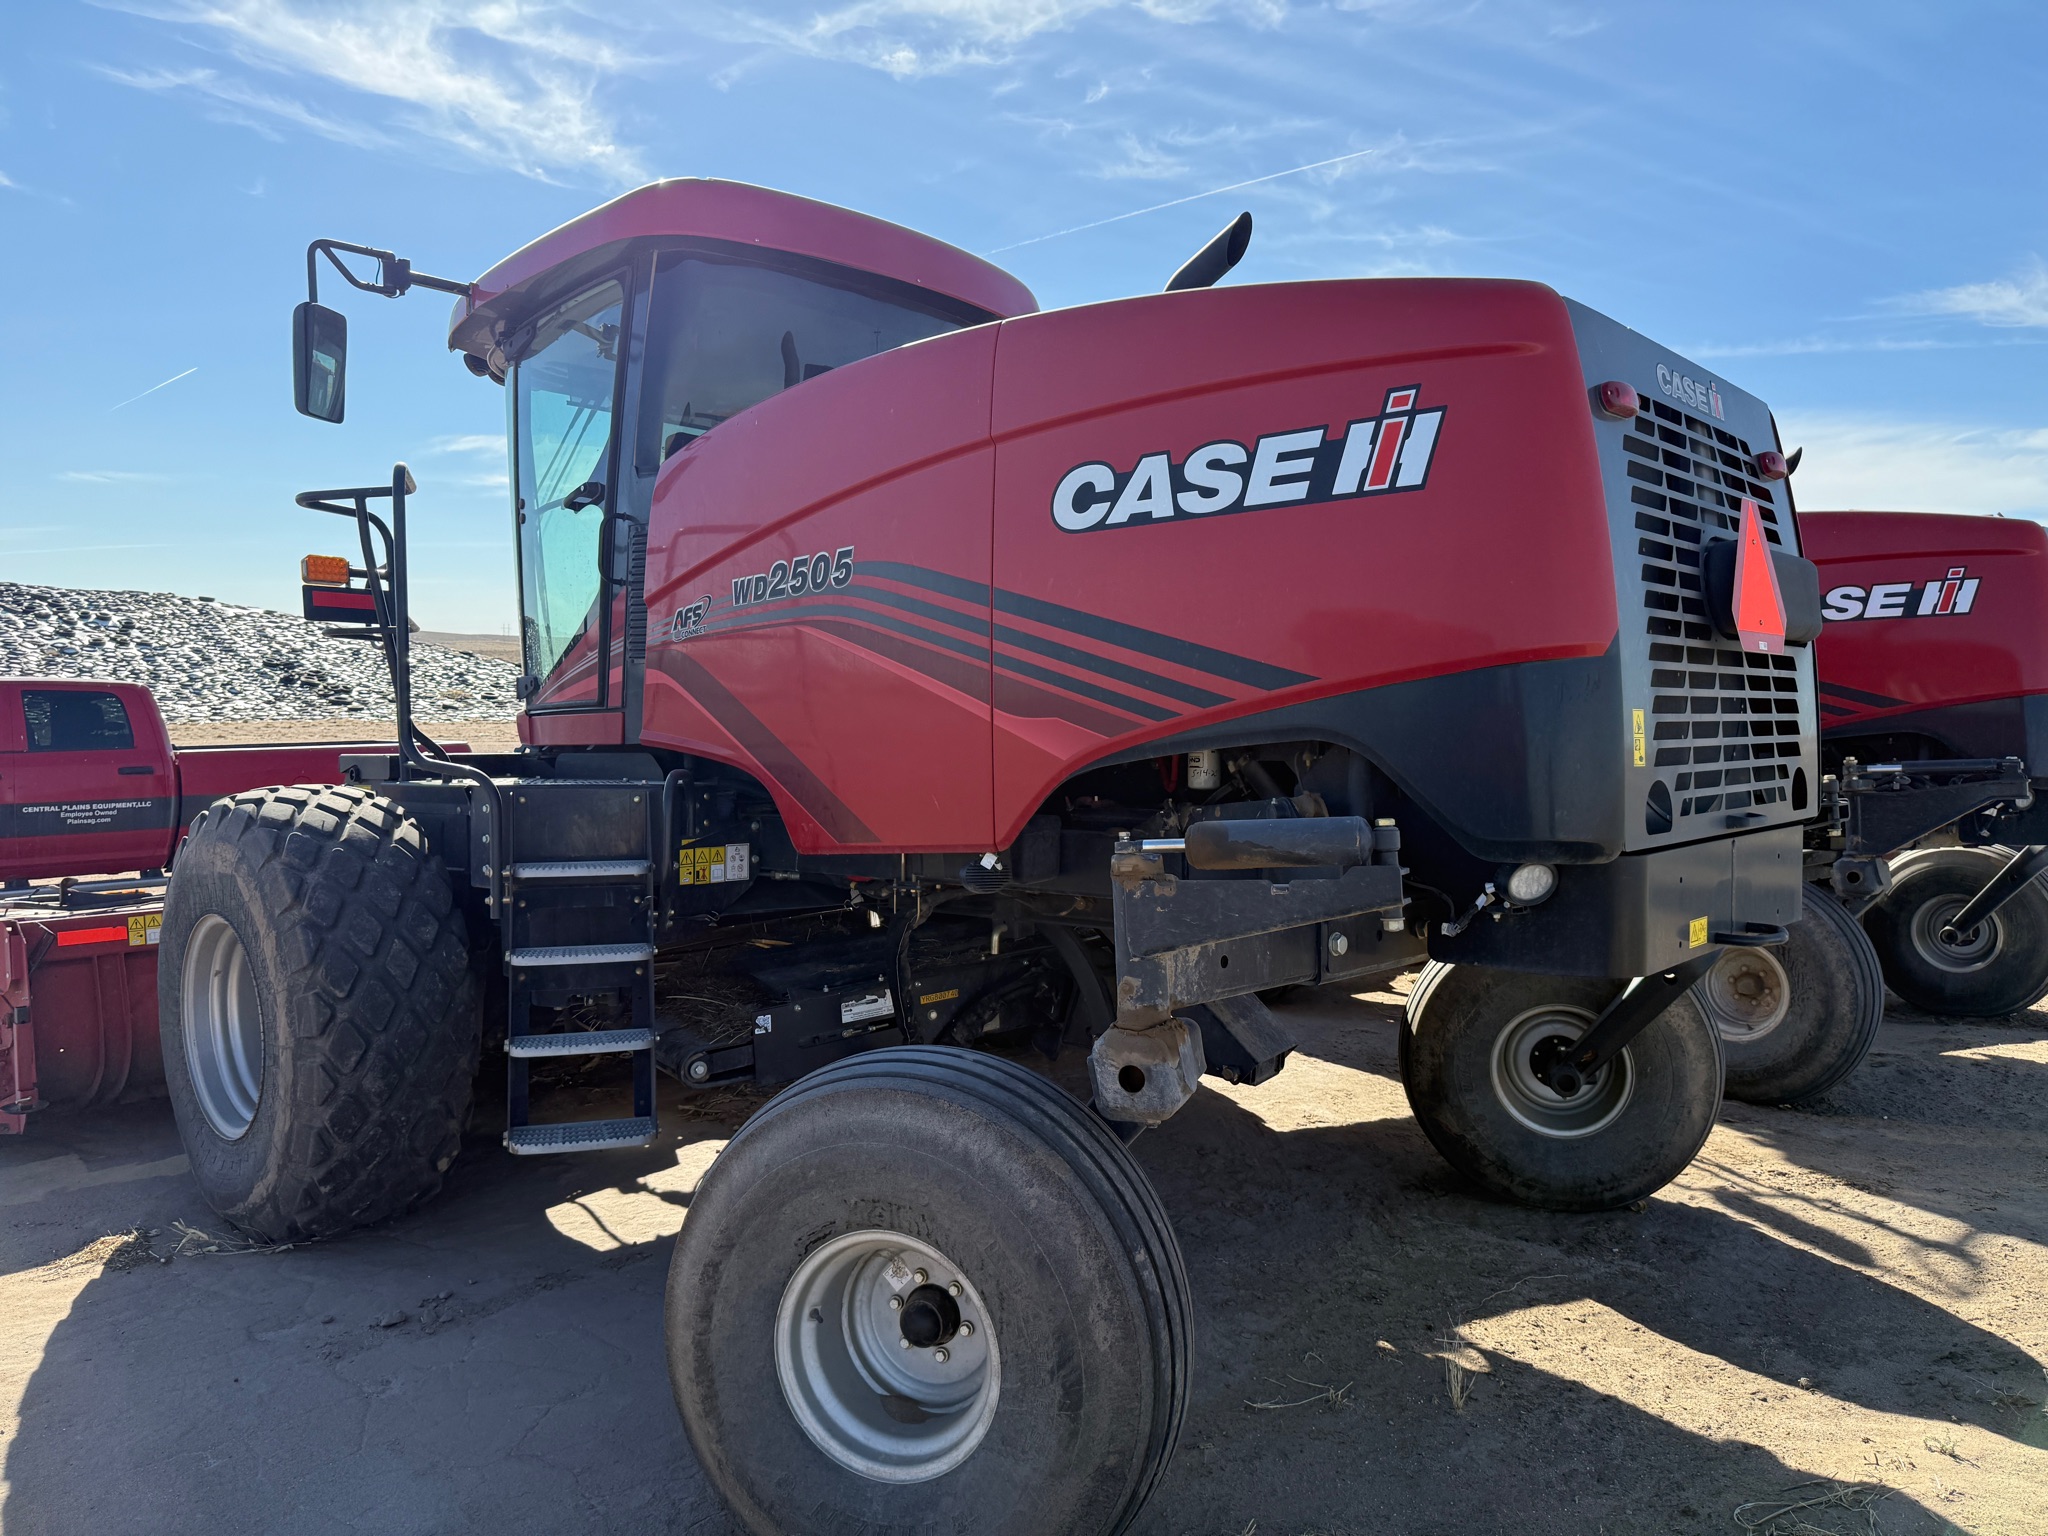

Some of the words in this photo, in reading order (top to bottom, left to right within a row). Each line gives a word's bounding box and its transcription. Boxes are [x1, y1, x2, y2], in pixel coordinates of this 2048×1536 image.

[1656, 363, 1709, 414] CASE
[1052, 427, 1326, 532] CASE
[732, 546, 854, 606] WD2505
[671, 601, 704, 633] AFS
[1821, 583, 1913, 621] SE
[681, 625, 707, 639] CONNECT
[22, 805, 61, 813] CENTRAL
[66, 817, 112, 825] Plainsag.com
